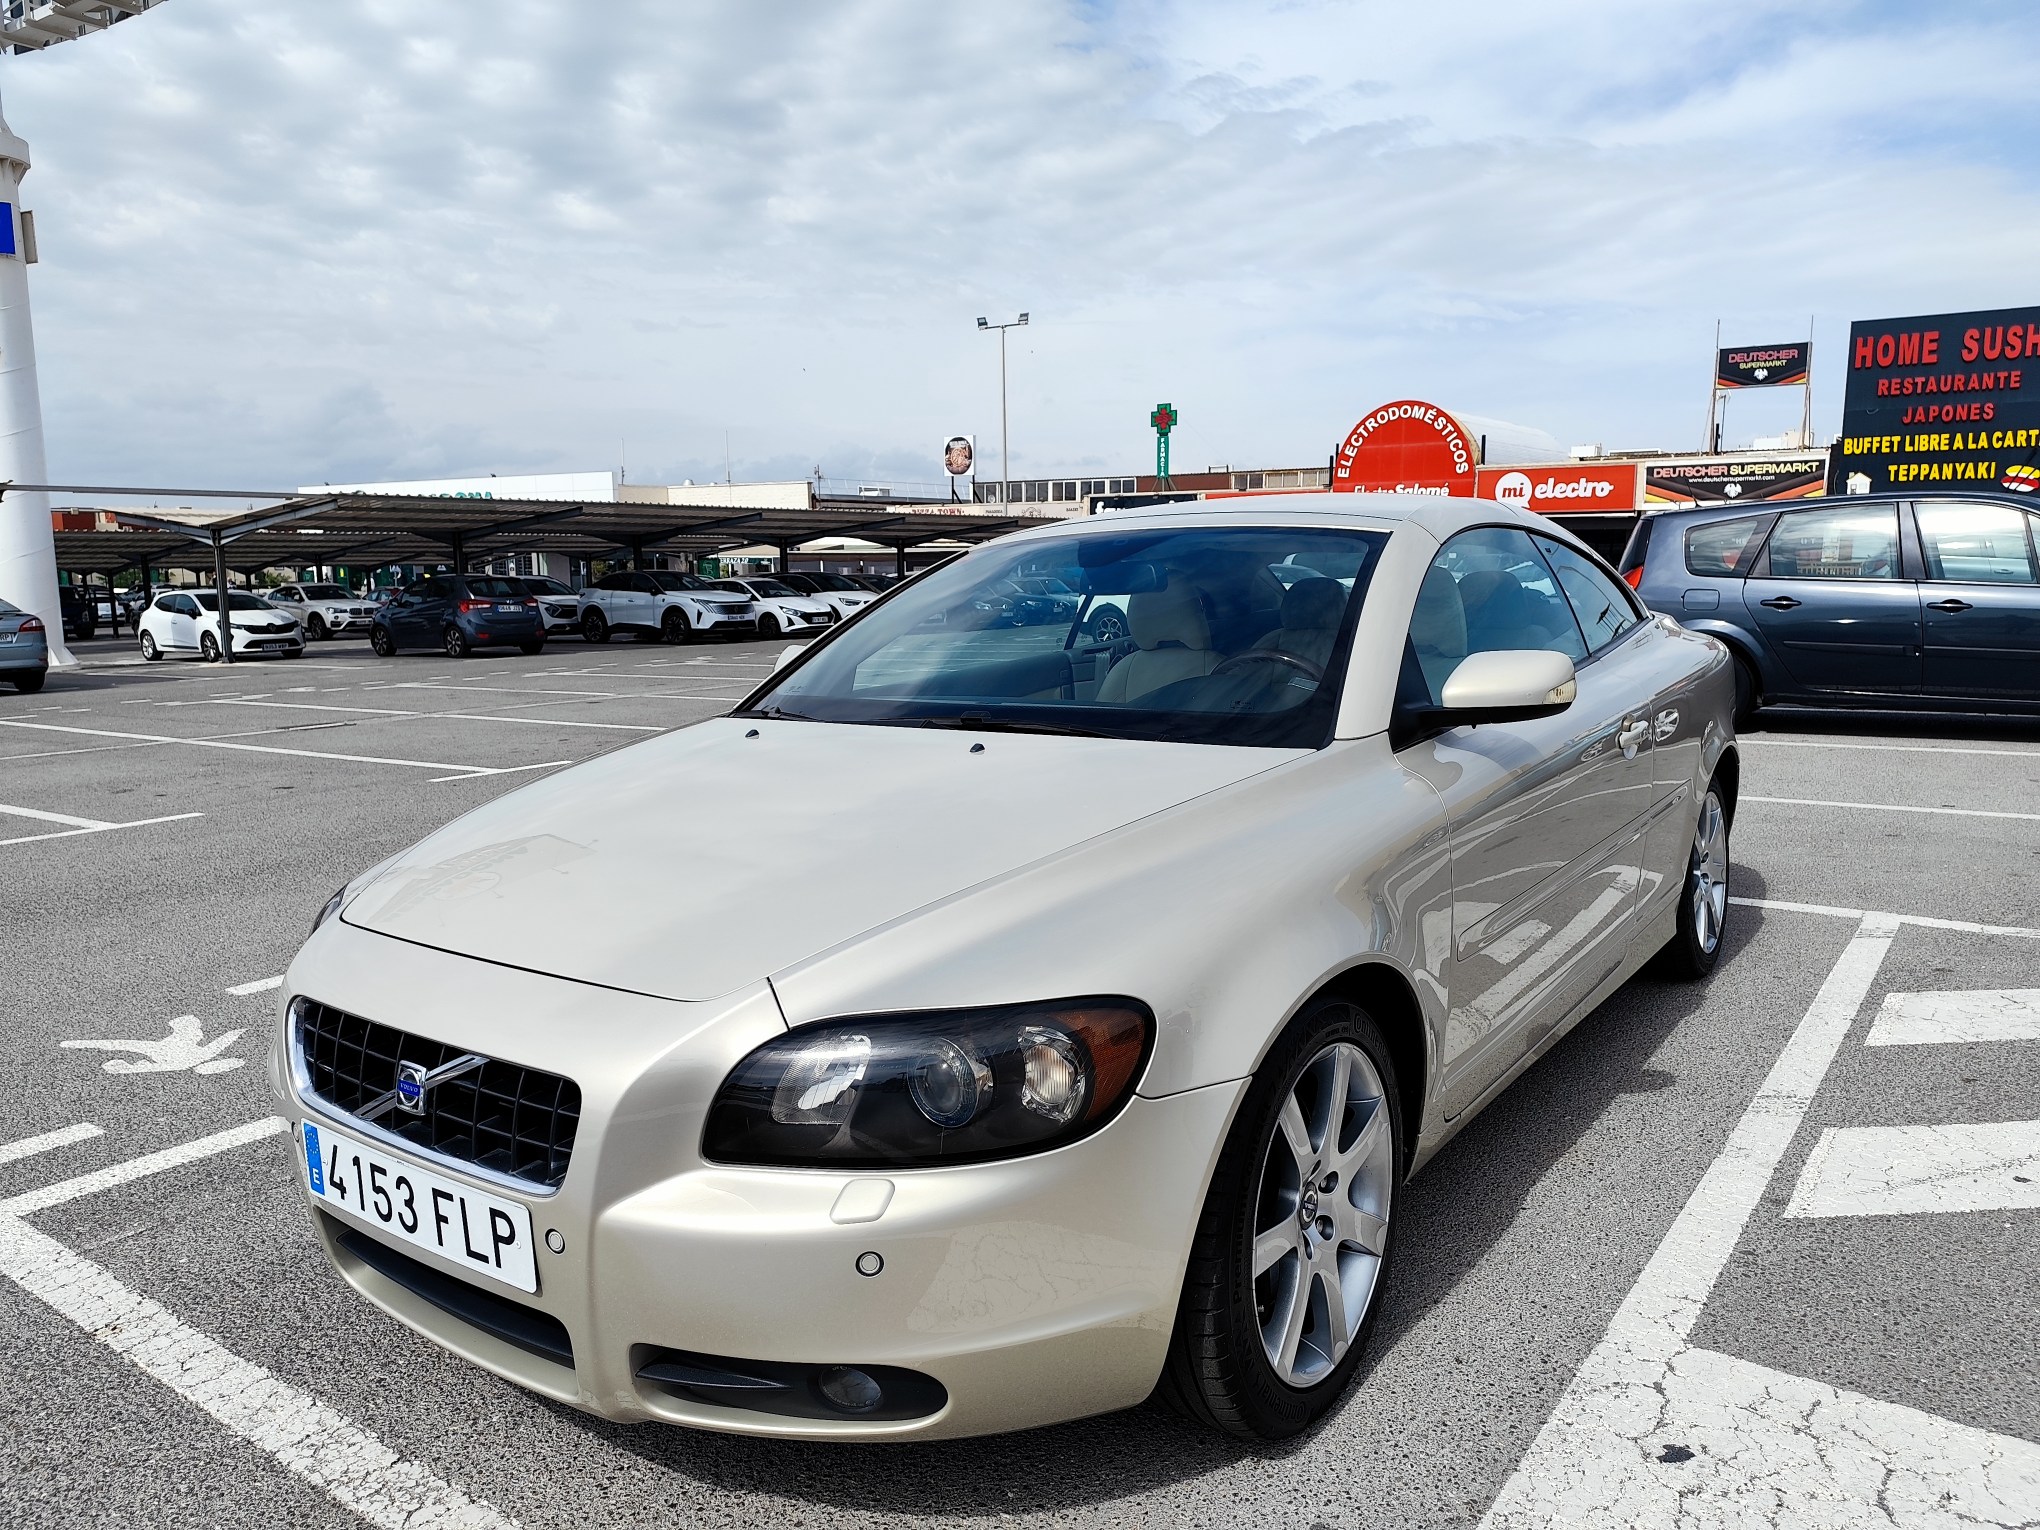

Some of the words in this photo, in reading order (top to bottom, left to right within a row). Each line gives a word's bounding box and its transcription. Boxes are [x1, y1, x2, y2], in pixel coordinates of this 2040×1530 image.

[1728, 349, 1799, 364] DEUTSCHER
[1854, 330, 1940, 369] HOME
[1738, 359, 1788, 370] SUPERMARKT
[1877, 371, 2022, 396] RESTAURANTE
[1901, 402, 1995, 425] JAPONES
[1337, 404, 1470, 478] ELECTRODOMÉSTICOS
[1843, 436, 1901, 456] BUFFET
[1904, 433, 1950, 453] LIBRE
[1953, 432, 1964, 452] A
[1967, 432, 1989, 451] LA
[1991, 429, 2040, 449] CART
[1653, 465, 1728, 478] DEUTSCHER
[1730, 462, 1819, 476] SUPERMARKT
[1688, 475, 1775, 484] www.deutschersupermarkt.com
[1888, 462, 1996, 482] TEPPANYAKI
[1502, 482, 1526, 498] mi
[1534, 477, 1614, 499] electro
[312, 1168, 320, 1185] E
[329, 1144, 419, 1234] 4153
[431, 1186, 516, 1269] FLP
